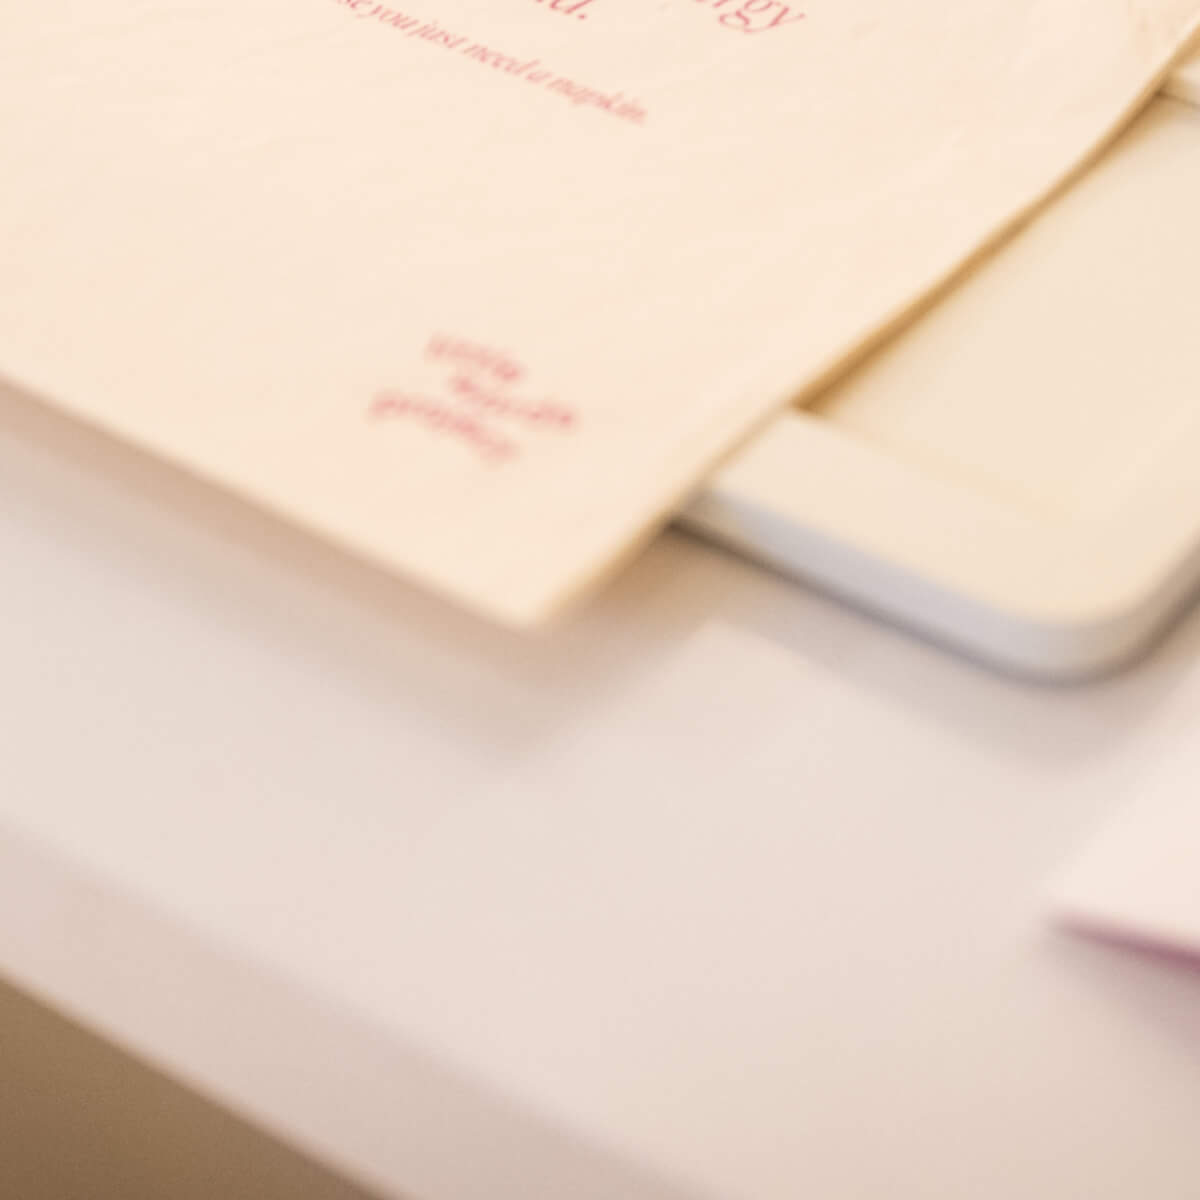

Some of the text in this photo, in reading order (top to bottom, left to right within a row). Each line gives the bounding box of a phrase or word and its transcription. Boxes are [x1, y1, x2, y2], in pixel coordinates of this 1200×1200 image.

[354, 4, 419, 31] you
[402, 19, 470, 49] just
[459, 43, 541, 77] need
[524, 69, 554, 85] a
